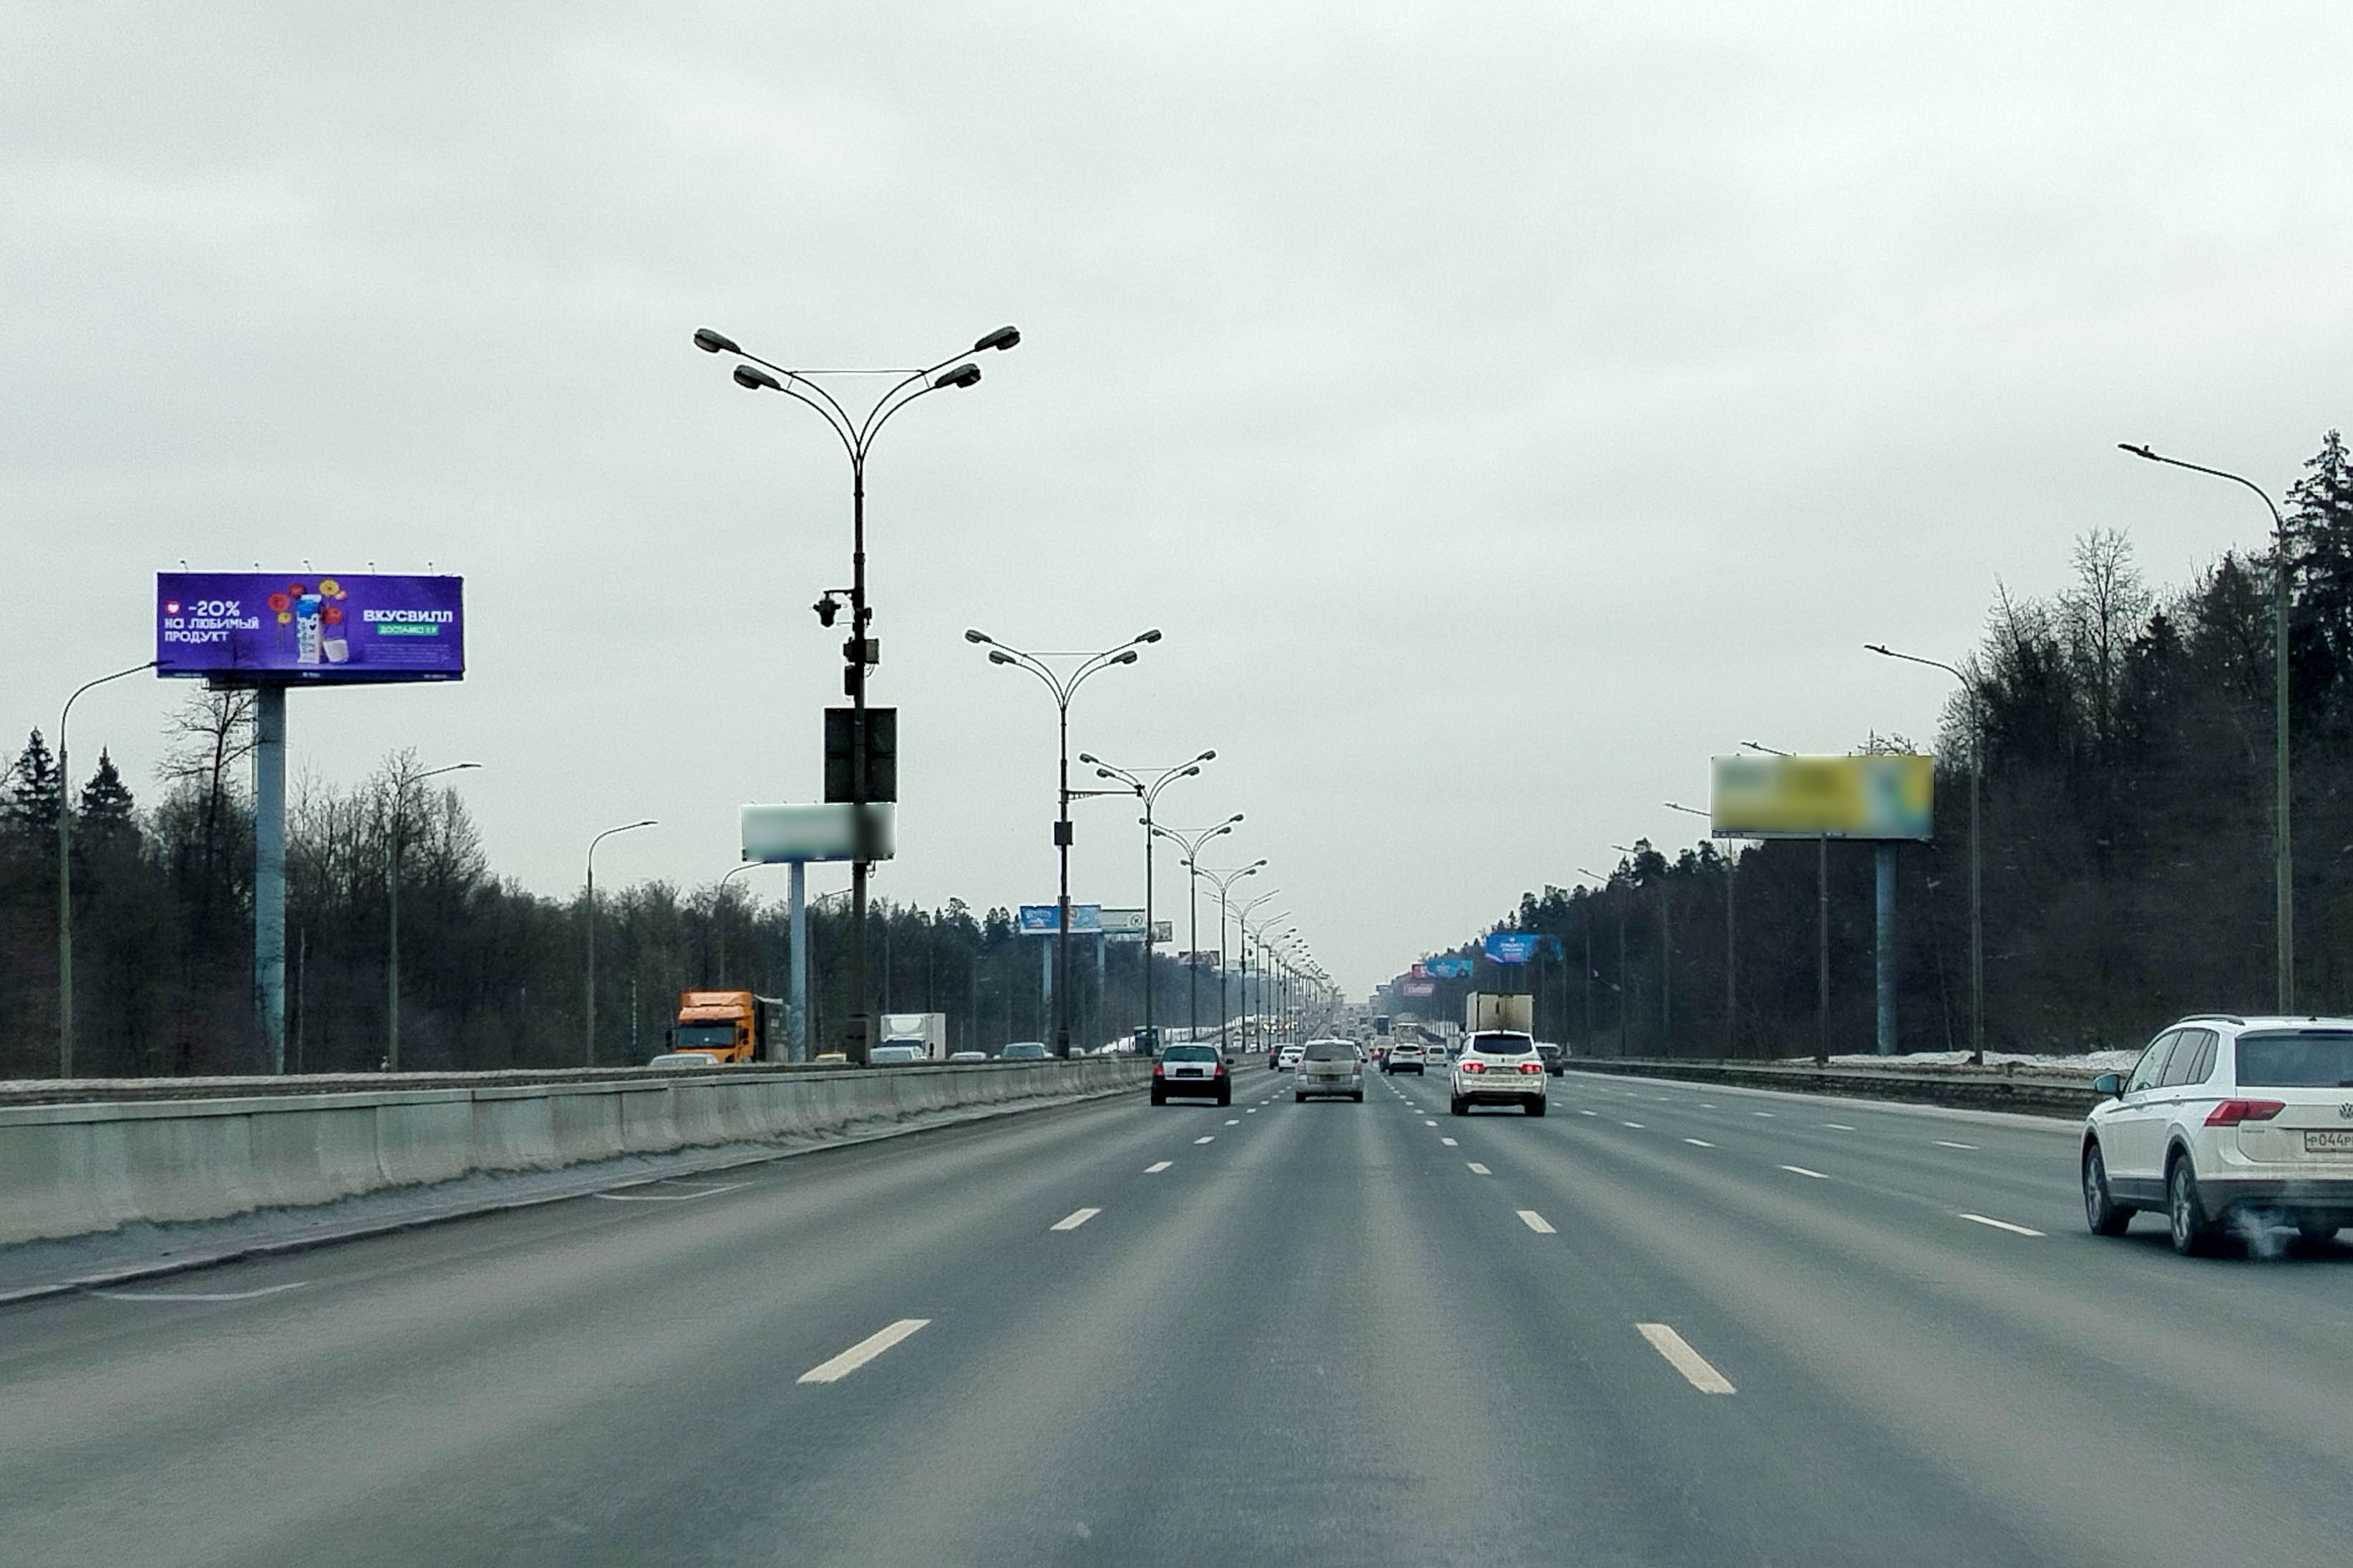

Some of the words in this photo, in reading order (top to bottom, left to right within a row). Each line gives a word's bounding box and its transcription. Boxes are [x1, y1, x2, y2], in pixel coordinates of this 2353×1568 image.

[188, 600, 240, 617] -20%
[188, 616, 259, 629] ЛЮБИМЫЙ
[363, 609, 453, 623] ВКУСВИЛЛ
[165, 630, 229, 643] ПРОДУКТ
